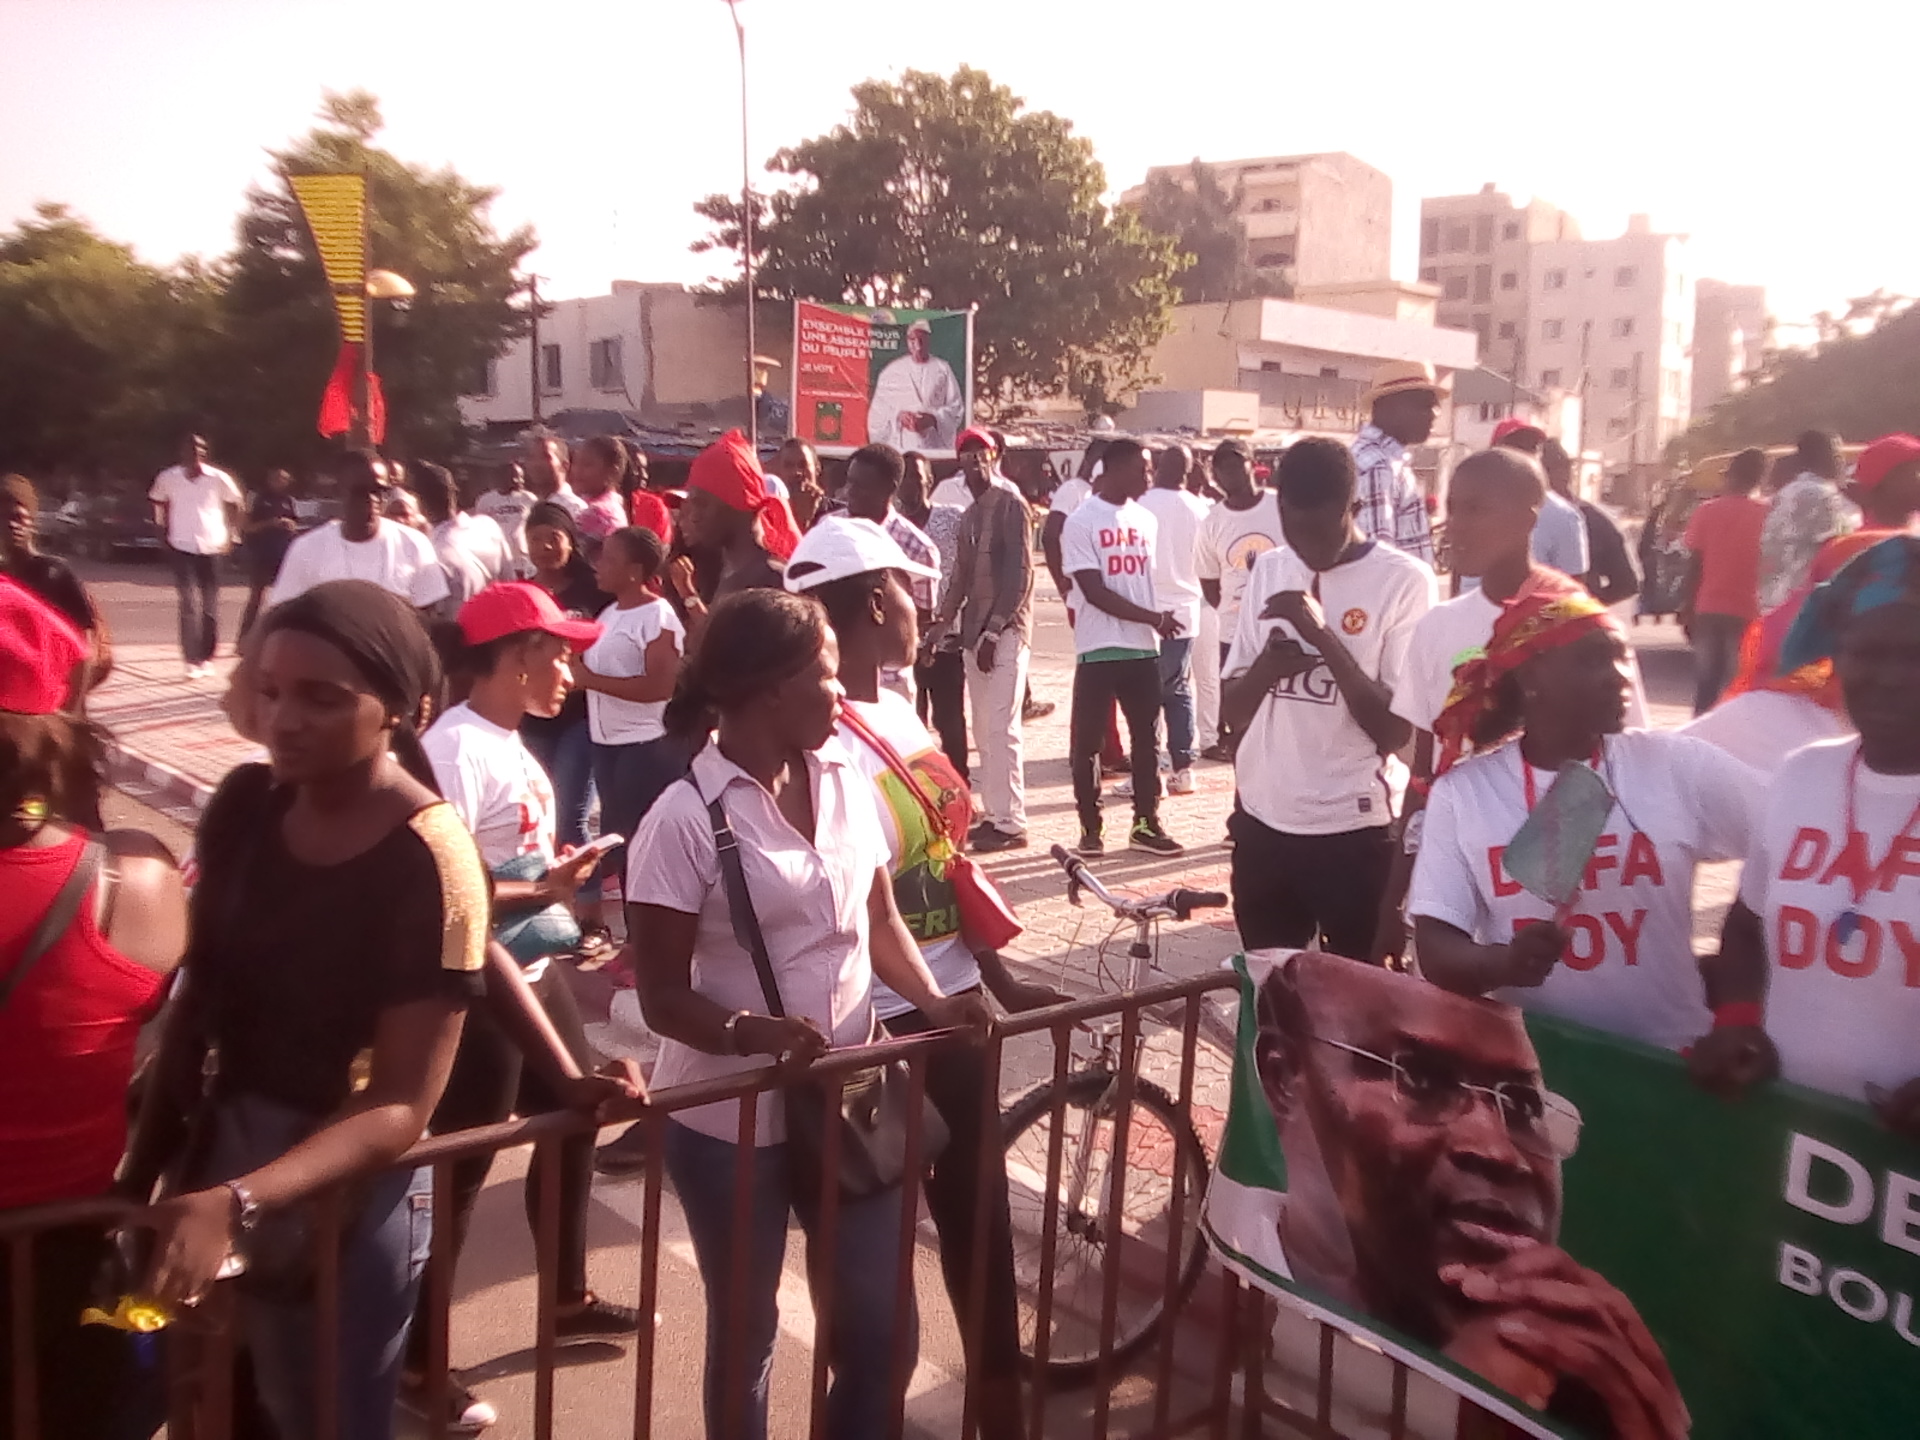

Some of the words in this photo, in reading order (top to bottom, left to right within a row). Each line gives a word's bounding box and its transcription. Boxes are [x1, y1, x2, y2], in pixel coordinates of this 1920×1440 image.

[802, 319, 865, 337] ENSEMBLE
[867, 328, 901, 340] POUR
[802, 330, 827, 344] UNE
[801, 341, 819, 354] DU
[823, 344, 866, 360] PEUPLE
[1099, 527, 1151, 549] DAFA
[1107, 554, 1148, 577] DOY
[1488, 832, 1666, 897] DFA
[1512, 909, 1649, 971] OY
